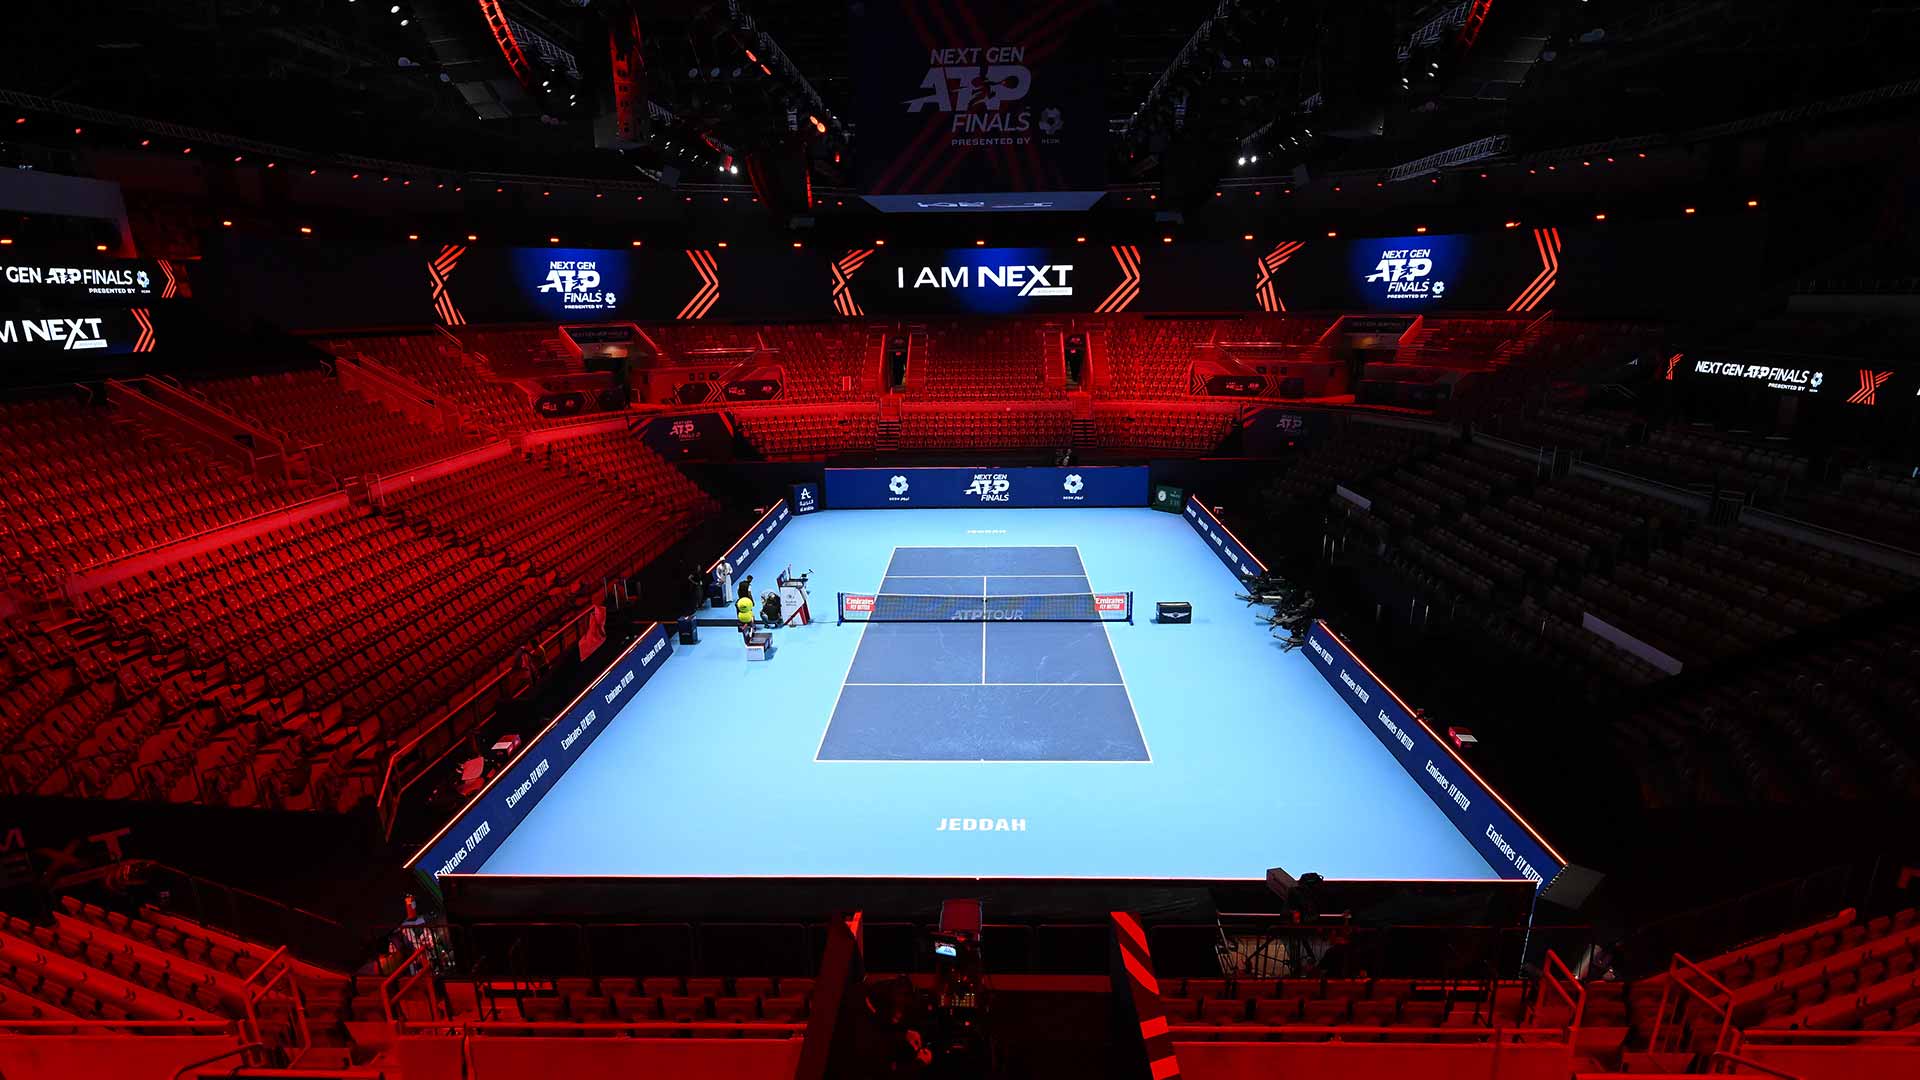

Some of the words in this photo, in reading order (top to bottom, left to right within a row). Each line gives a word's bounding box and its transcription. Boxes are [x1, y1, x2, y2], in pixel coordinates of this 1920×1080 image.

[930, 48, 982, 65] NEXT
[985, 46, 1025, 63] GEN
[899, 65, 1032, 112] ATP
[951, 111, 1031, 133] FINALS
[951, 138, 1014, 146] PRESENTED
[1015, 137, 1031, 145] BY
[1382, 250, 1409, 259] NEXT
[1409, 249, 1431, 258] GEN
[550, 261, 575, 270] NEXT
[576, 261, 596, 270] GEN
[1365, 258, 1432, 282] ATP
[5, 266, 42, 284] GEN
[45, 267, 82, 285] ATP
[83, 269, 133, 286] FINALS
[537, 270, 600, 292] ATP
[897, 266, 904, 288] I
[914, 266, 969, 288] AM
[978, 265, 1074, 297] NEXT
[1388, 281, 1430, 292] FINALS
[564, 292, 602, 303] FINALS
[22, 317, 102, 350] NEXT
[1695, 361, 1723, 374] NEXT
[1722, 363, 1745, 377] GEN
[1743, 365, 1770, 379] ATP
[1768, 367, 1810, 383] FINALS
[1768, 382, 1797, 391] PRESENTED
[963, 480, 1010, 494] ATP
[980, 494, 1009, 502] FINALS
[846, 597, 874, 605] Emirates
[951, 609, 983, 620] ATP
[986, 609, 1023, 620] TOUR
[1308, 635, 1323, 655] Emirates
[641, 649, 656, 667] Emirates
[1340, 669, 1356, 691] Emirates
[605, 683, 622, 704] Emirates
[1378, 709, 1398, 735] Emirates
[561, 726, 583, 750] Emirates
[505, 779, 532, 808] Emirates
[530, 770, 538, 784] FLY
[1425, 760, 1449, 790] Emirates
[1447, 783, 1457, 797] FLY
[1454, 790, 1471, 811] BETTER
[936, 817, 1026, 831] JEDDAH
[433, 847, 467, 881] Emirates
[465, 835, 476, 852] FLY
[472, 820, 491, 844] BETTER
[1485, 823, 1516, 861] Emirates
[1514, 855, 1526, 871] FLY
[1522, 863, 1544, 889] BETTER
